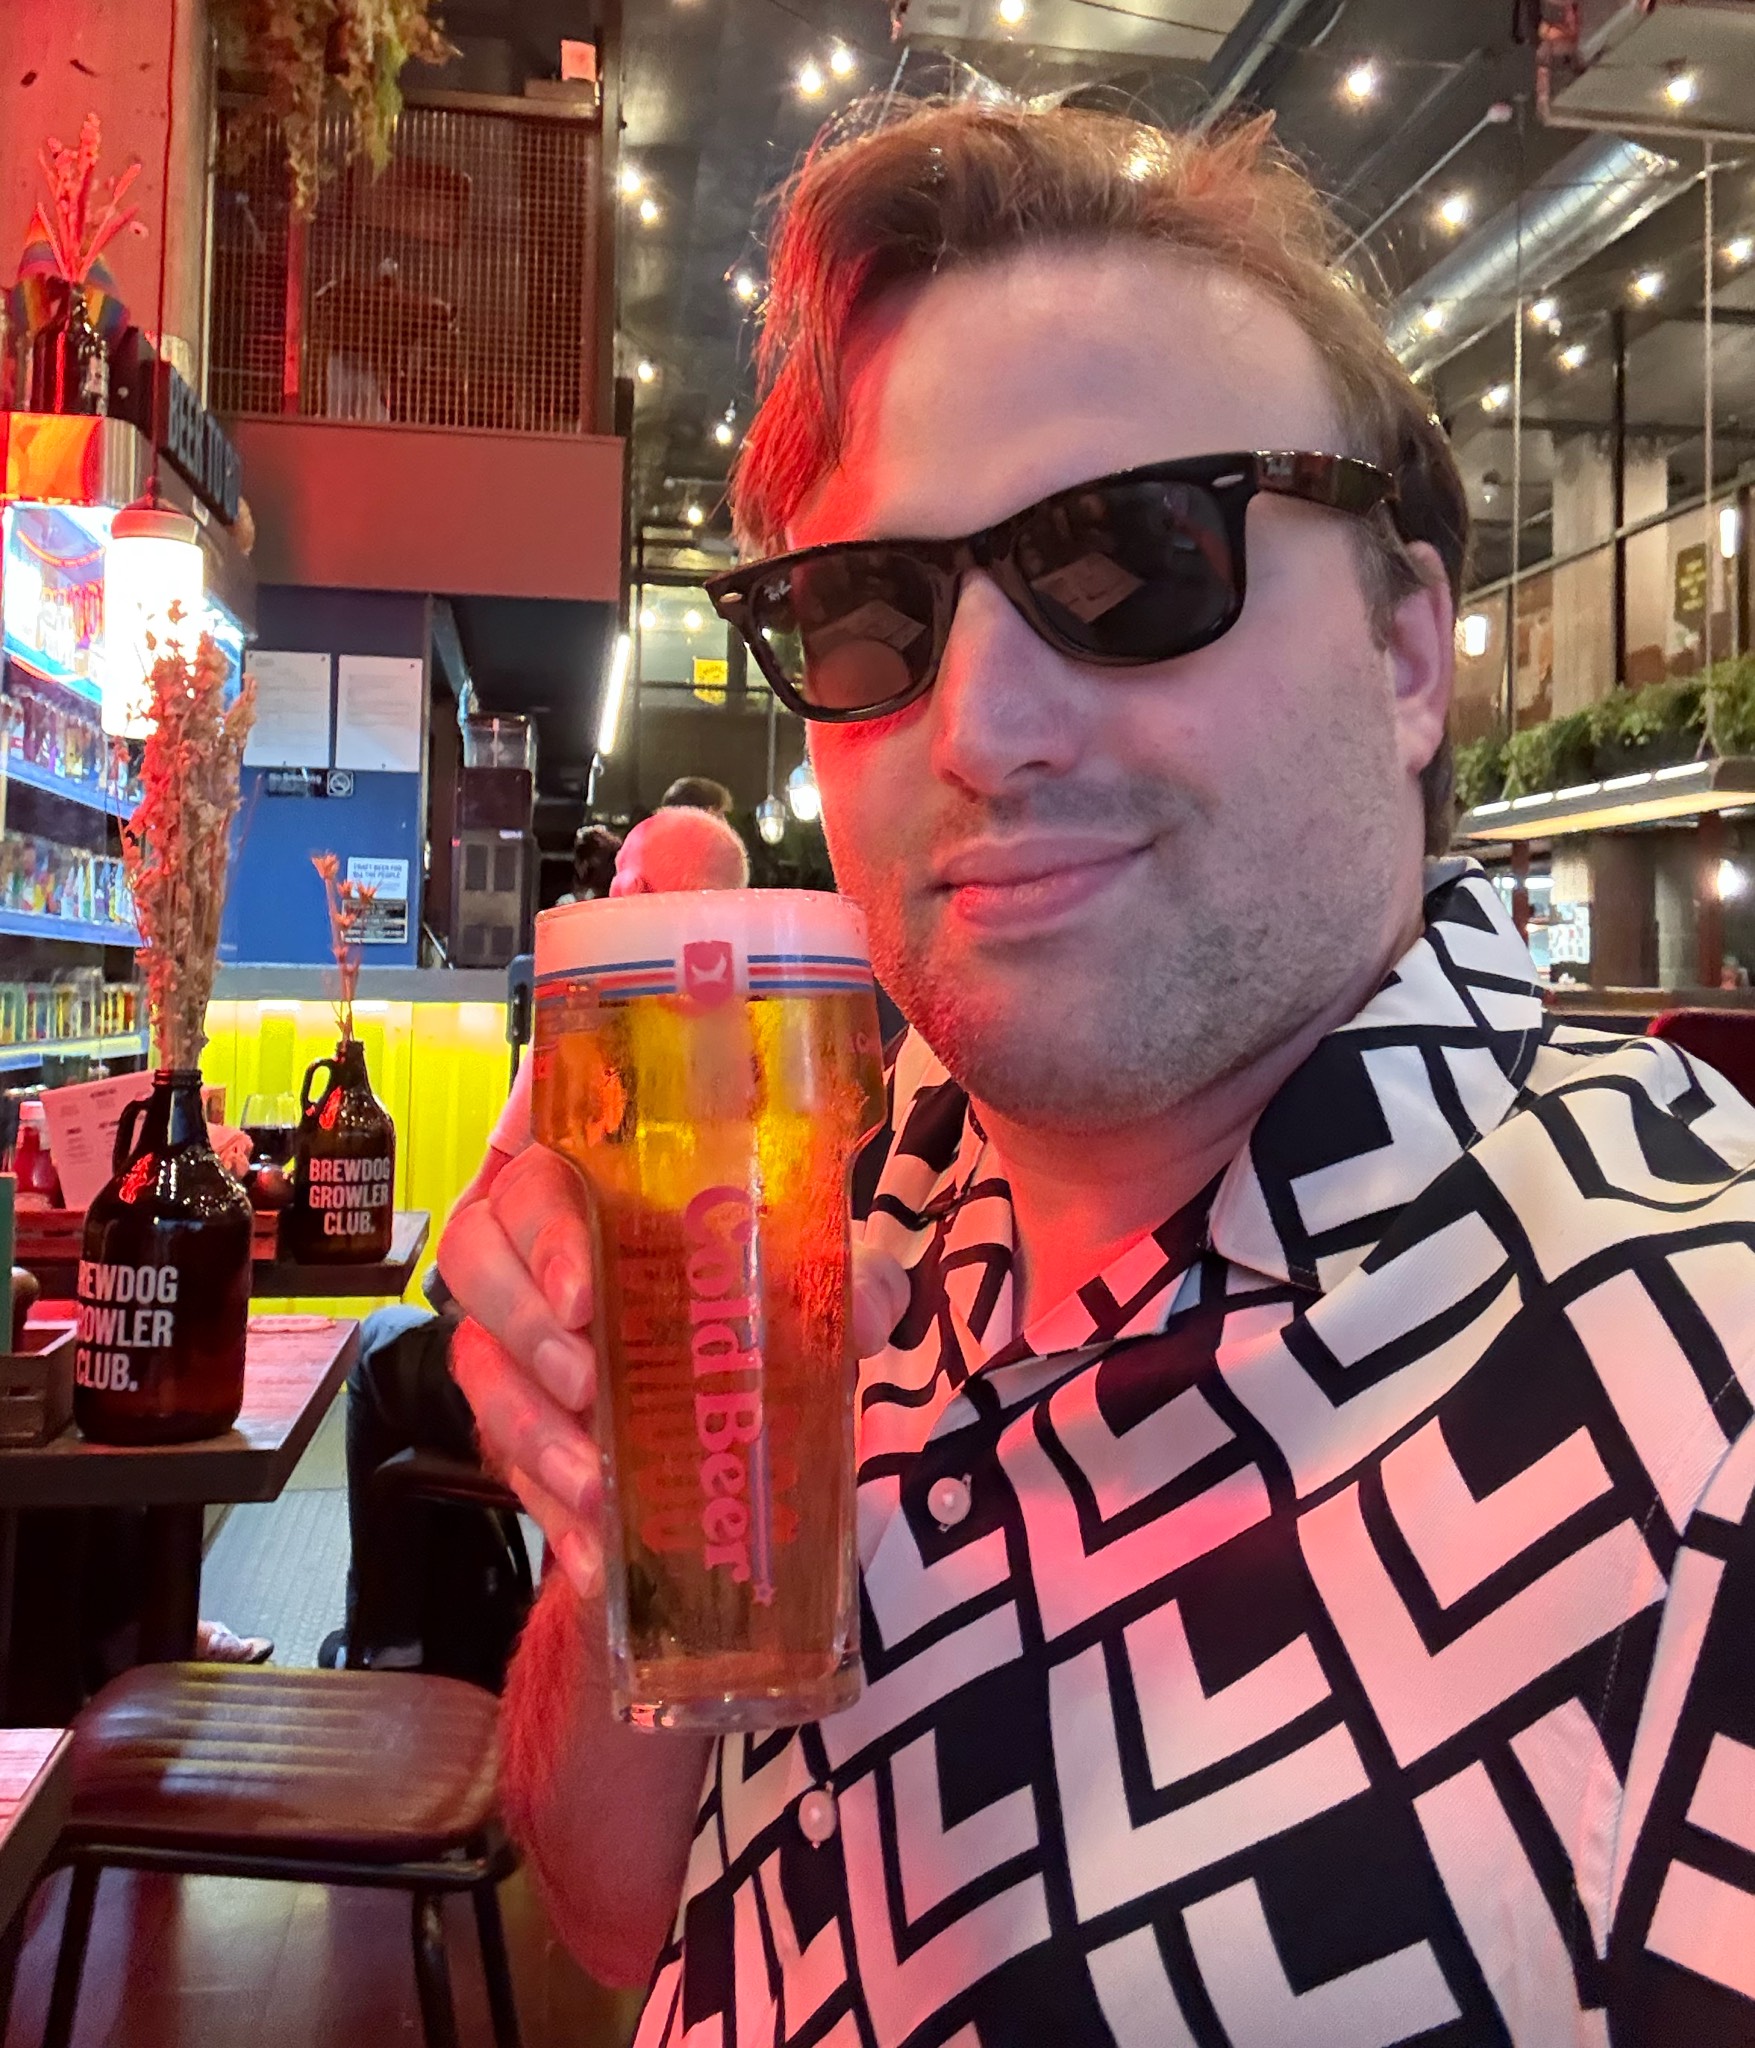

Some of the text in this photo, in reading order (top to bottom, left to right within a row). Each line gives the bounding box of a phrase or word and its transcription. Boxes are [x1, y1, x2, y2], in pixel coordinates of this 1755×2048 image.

[309, 1157, 391, 1182] BREWDOG
[309, 1183, 389, 1209] GROWLER
[323, 1211, 376, 1236] CLUB.
[77, 1259, 179, 1305] REWDOG
[76, 1347, 139, 1392] CLUB.
[684, 1184, 764, 1585] Cold Beer
